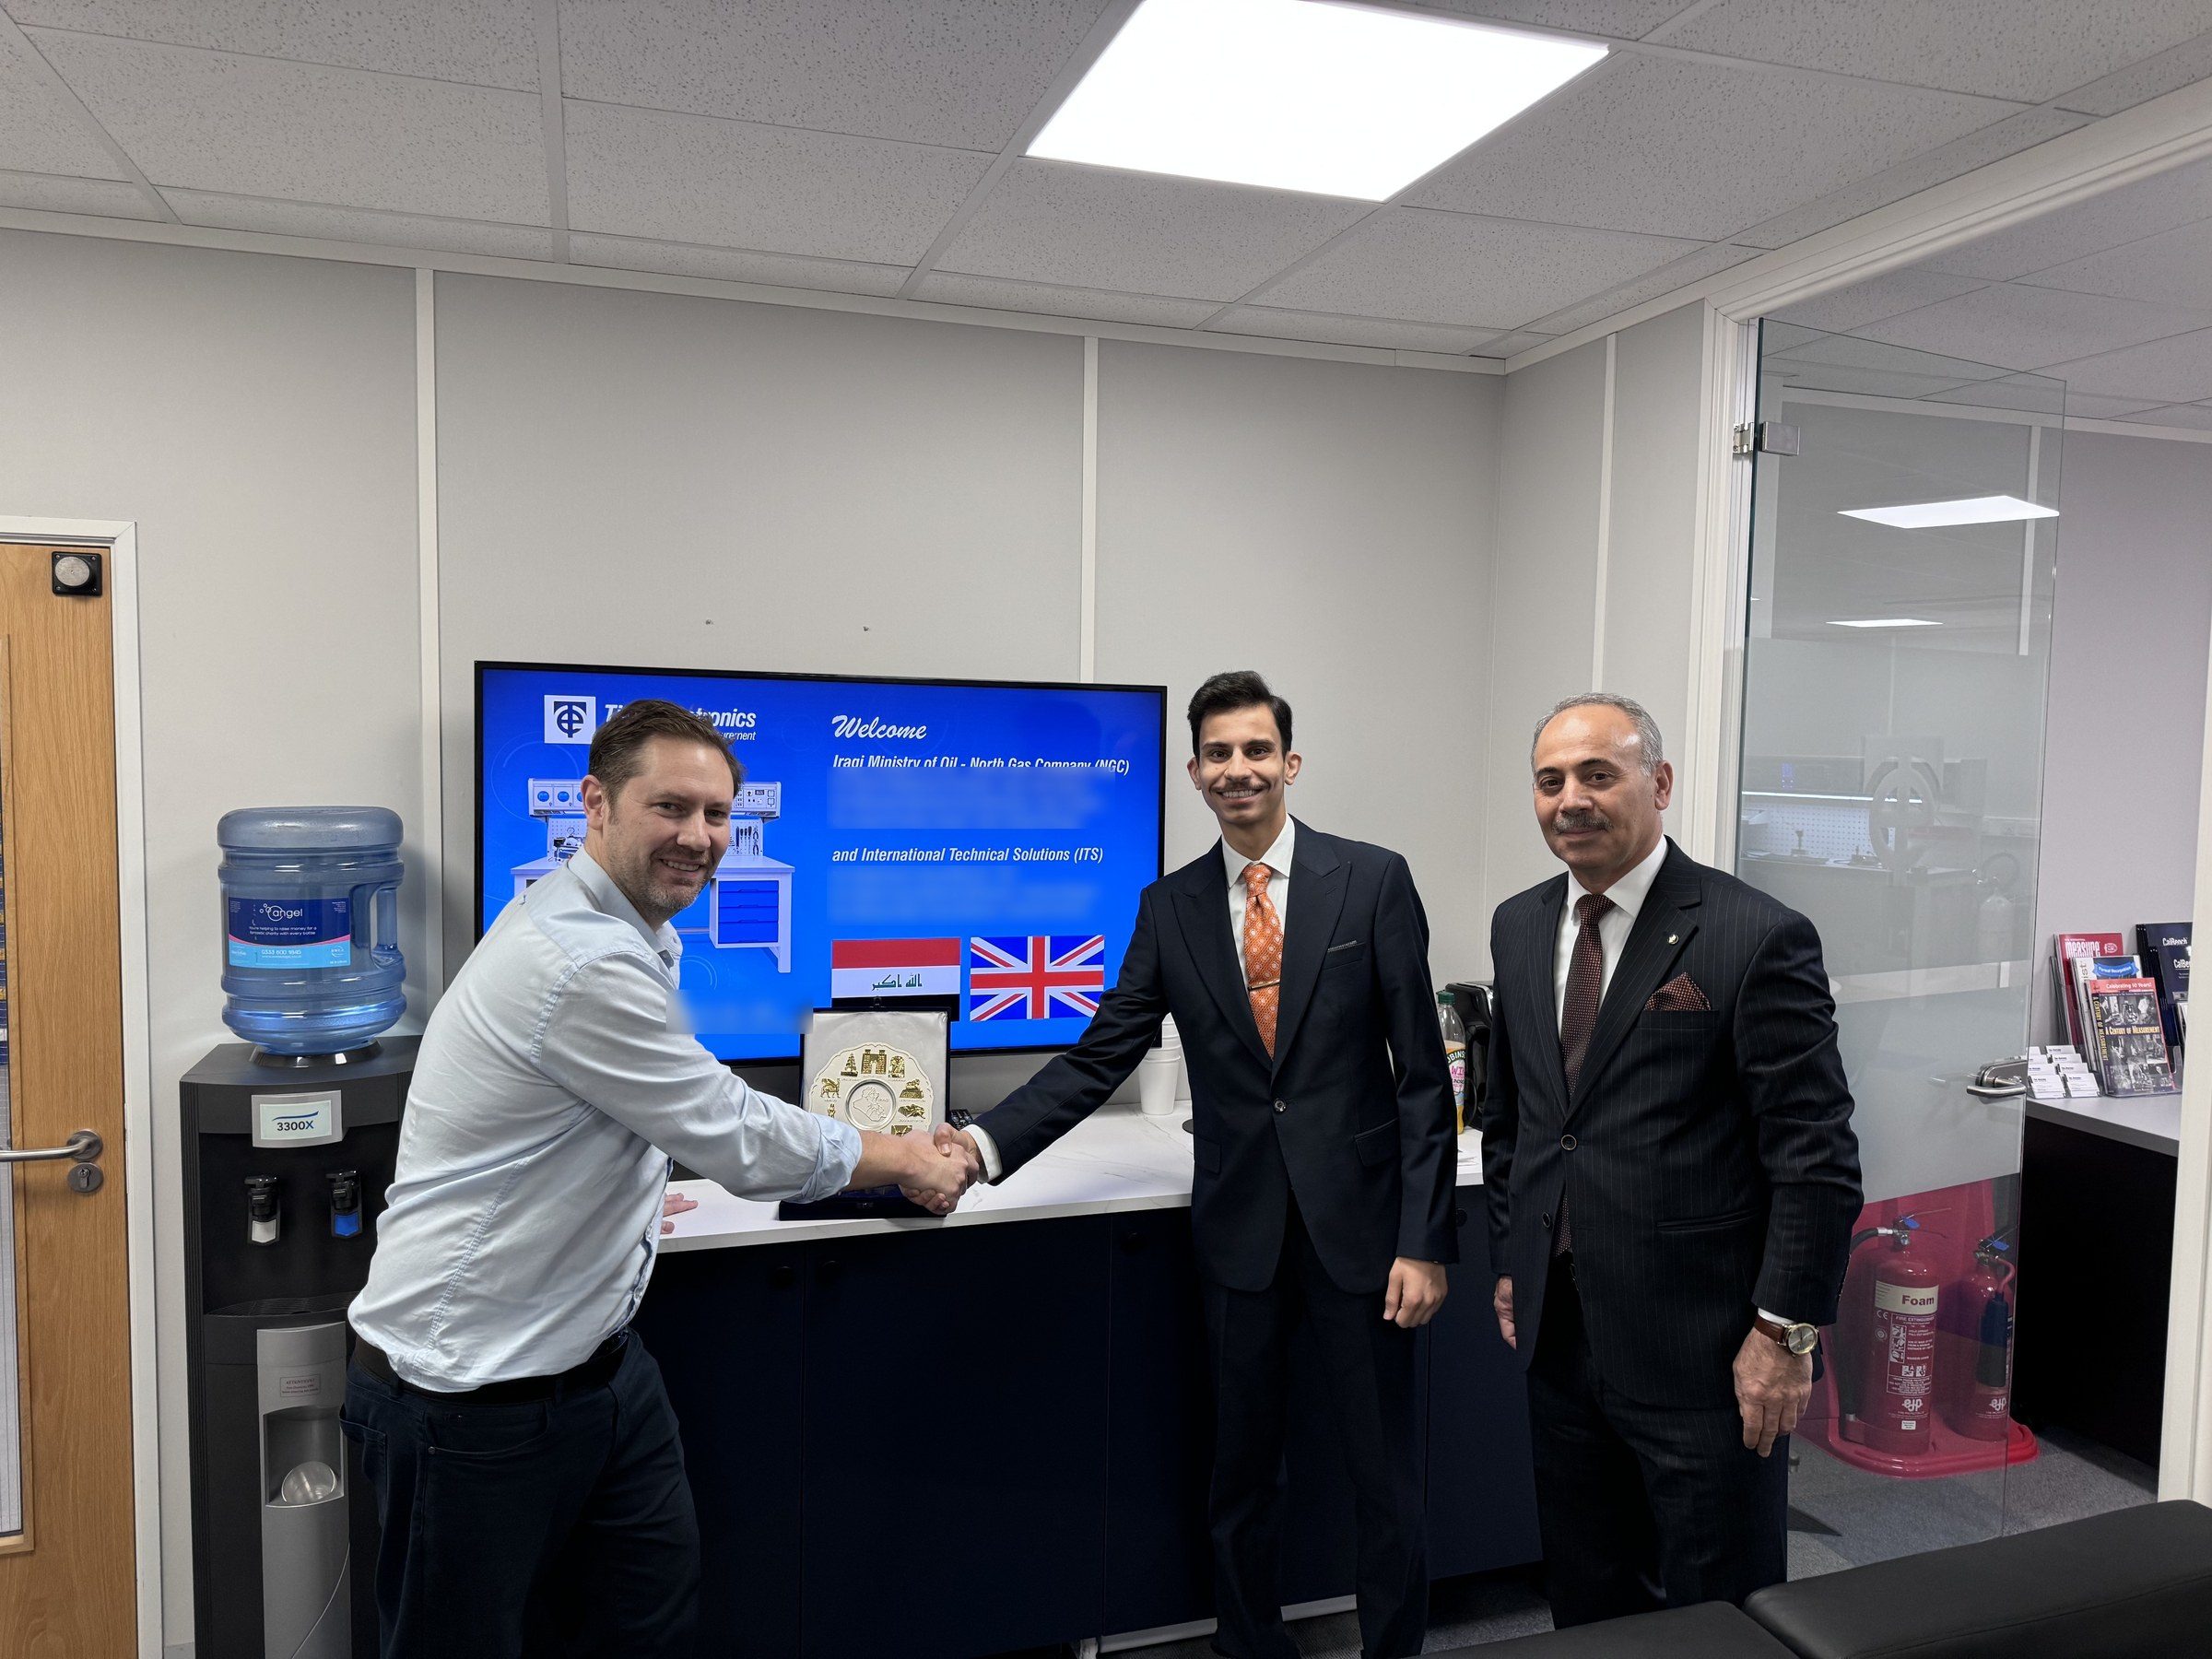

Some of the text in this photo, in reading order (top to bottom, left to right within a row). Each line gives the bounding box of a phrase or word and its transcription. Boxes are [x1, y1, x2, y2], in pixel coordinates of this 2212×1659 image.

[831, 714, 927, 740] Welcome
[924, 755, 938, 767] of
[940, 756, 959, 767] Oil
[970, 757, 1005, 768] North
[1008, 757, 1031, 768] Gas
[1095, 759, 1130, 775] (NGC)
[832, 847, 1103, 864] and International Technical Solutions (ITS)
[272, 908, 303, 919] angel
[2162, 937, 2188, 947] CalBench
[2065, 941, 2100, 959] measure
[2173, 959, 2191, 969] CalBe
[905, 972, 923, 987] الله
[2105, 1026, 2109, 1035] A
[276, 1120, 314, 1132] 3300X
[1901, 1294, 1935, 1306] Foam
